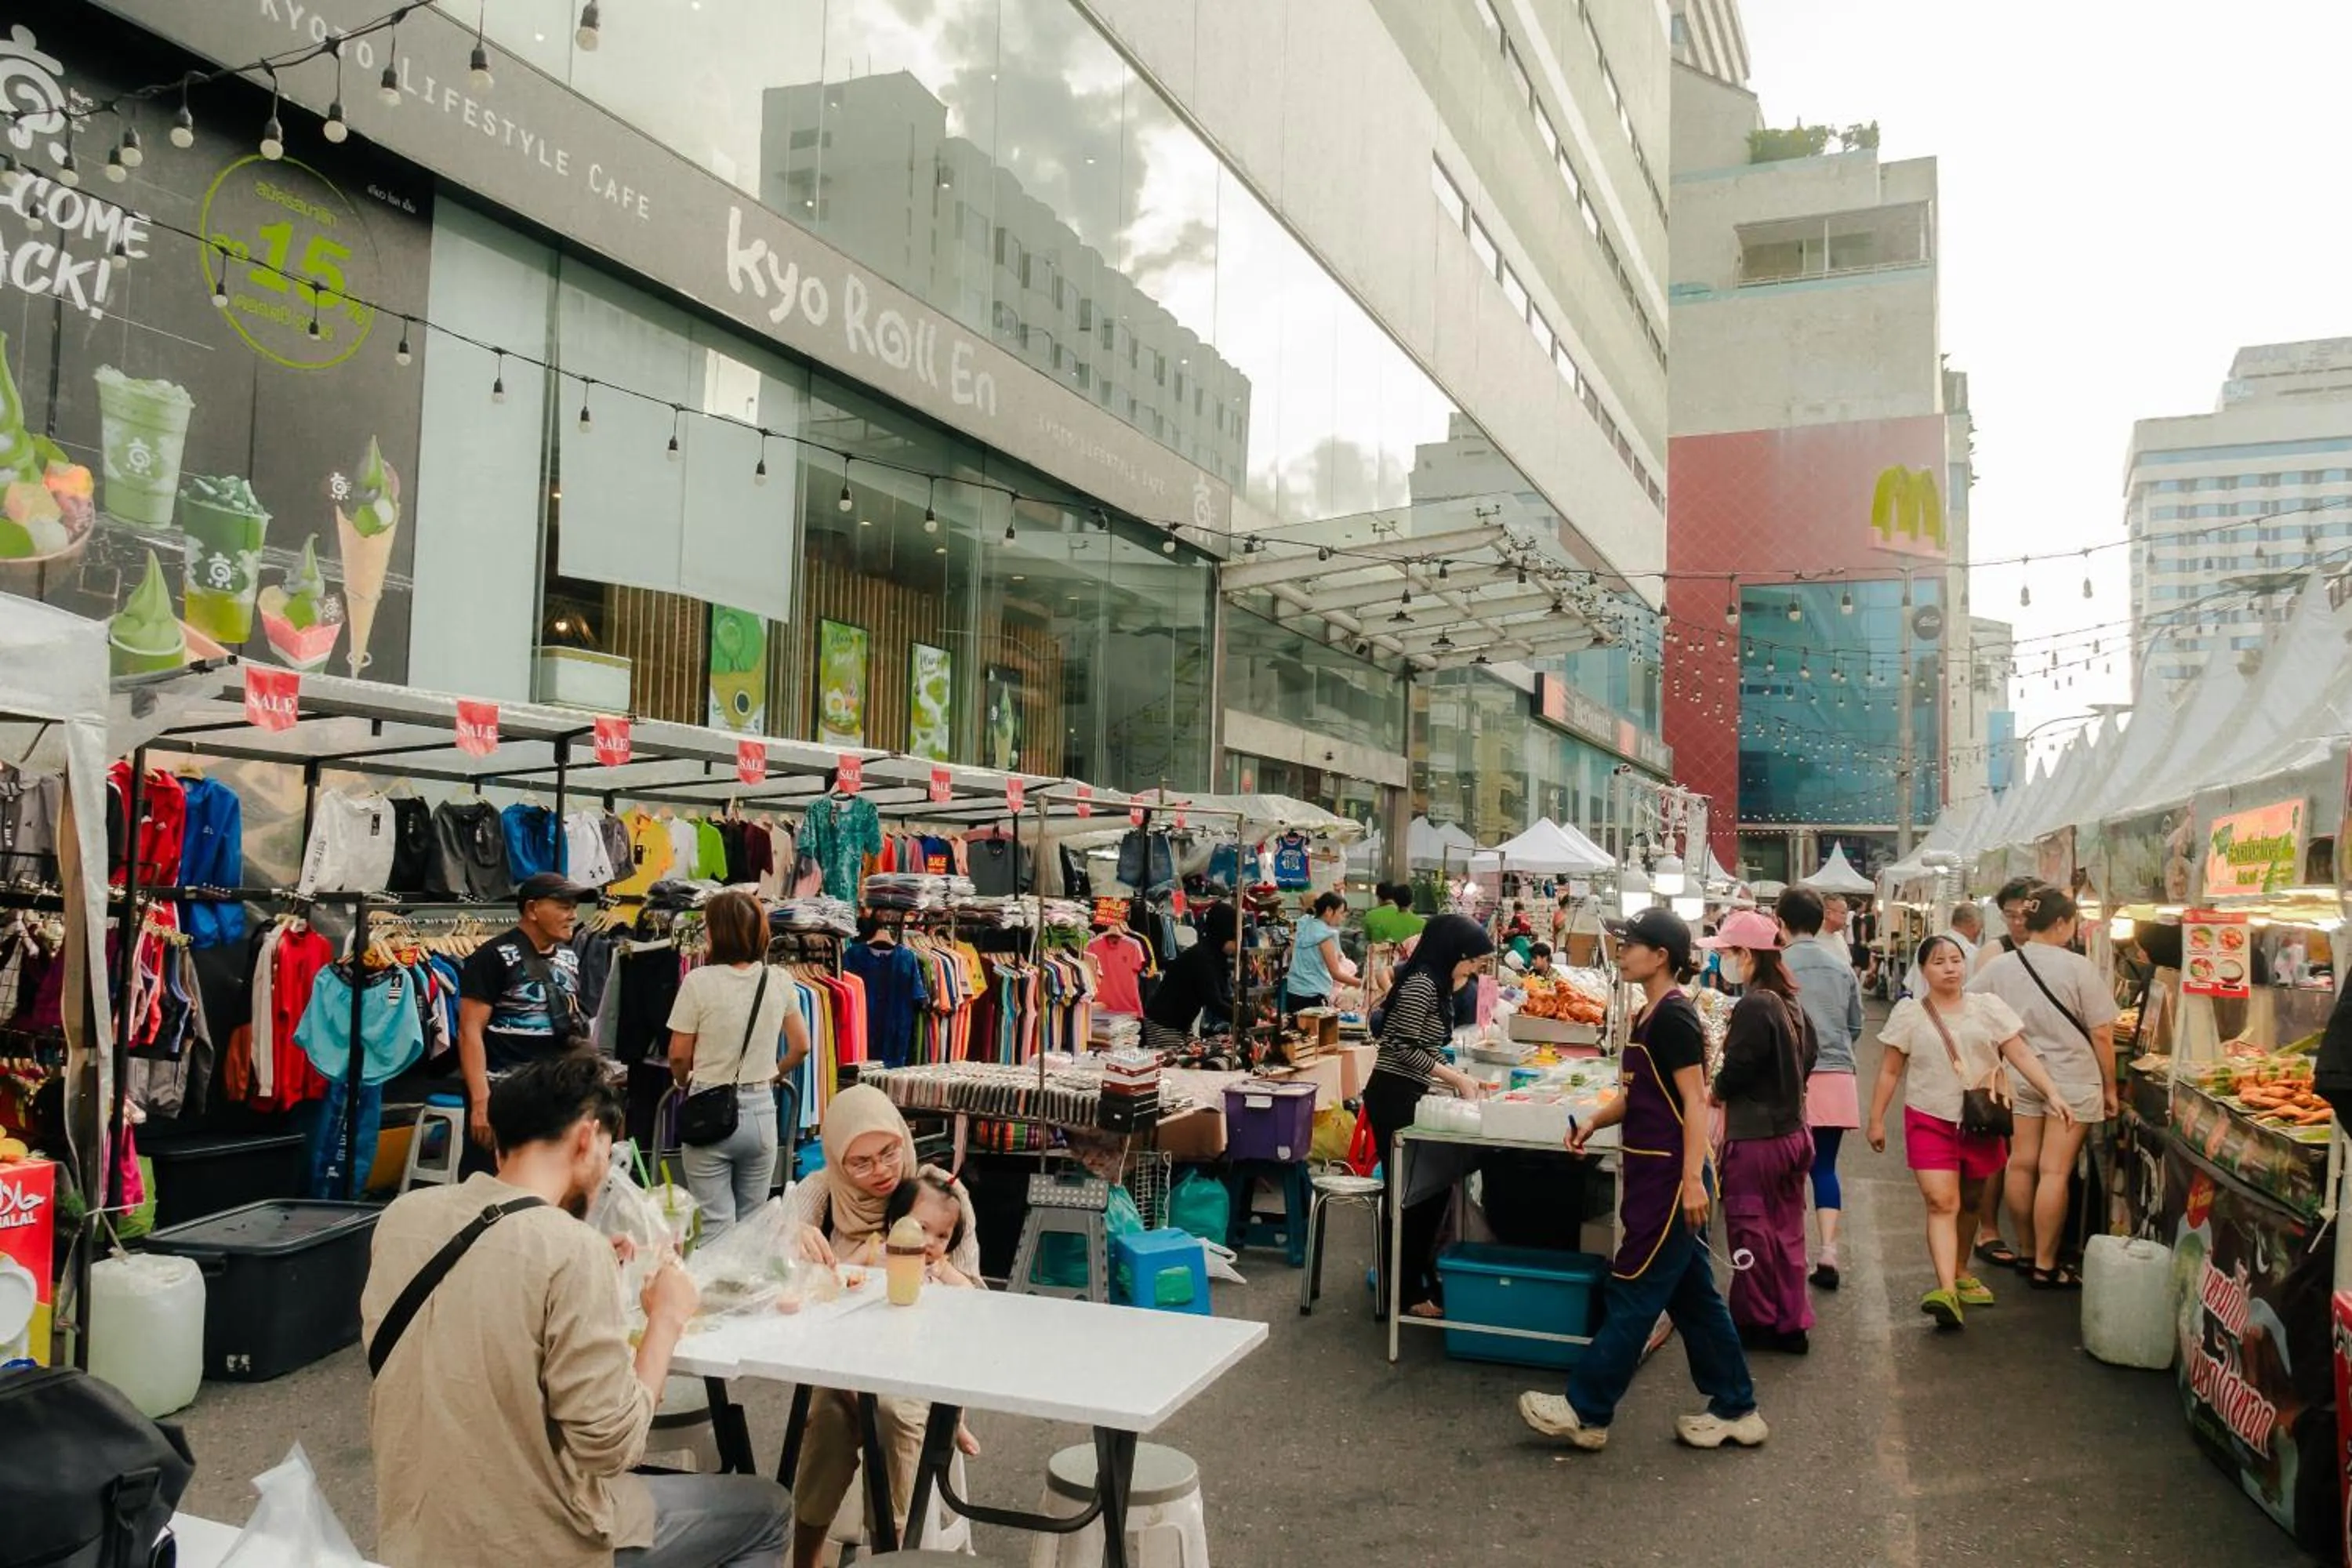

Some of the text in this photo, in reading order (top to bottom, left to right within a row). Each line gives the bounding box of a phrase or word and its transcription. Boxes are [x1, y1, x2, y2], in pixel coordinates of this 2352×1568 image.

[401, 57, 571, 177] LIFESTYLE
[587, 163, 651, 221] CAFE
[0, 172, 151, 259] COME
[0, 230, 111, 320] CK!
[844, 273, 938, 390] Roll
[951, 339, 997, 417] En
[248, 691, 296, 715] SALE
[459, 721, 497, 740] SALE
[596, 737, 628, 753] SALE
[739, 758, 764, 772] SALE
[839, 768, 860, 781] SALE
[0, 1209, 38, 1229] ALAL
